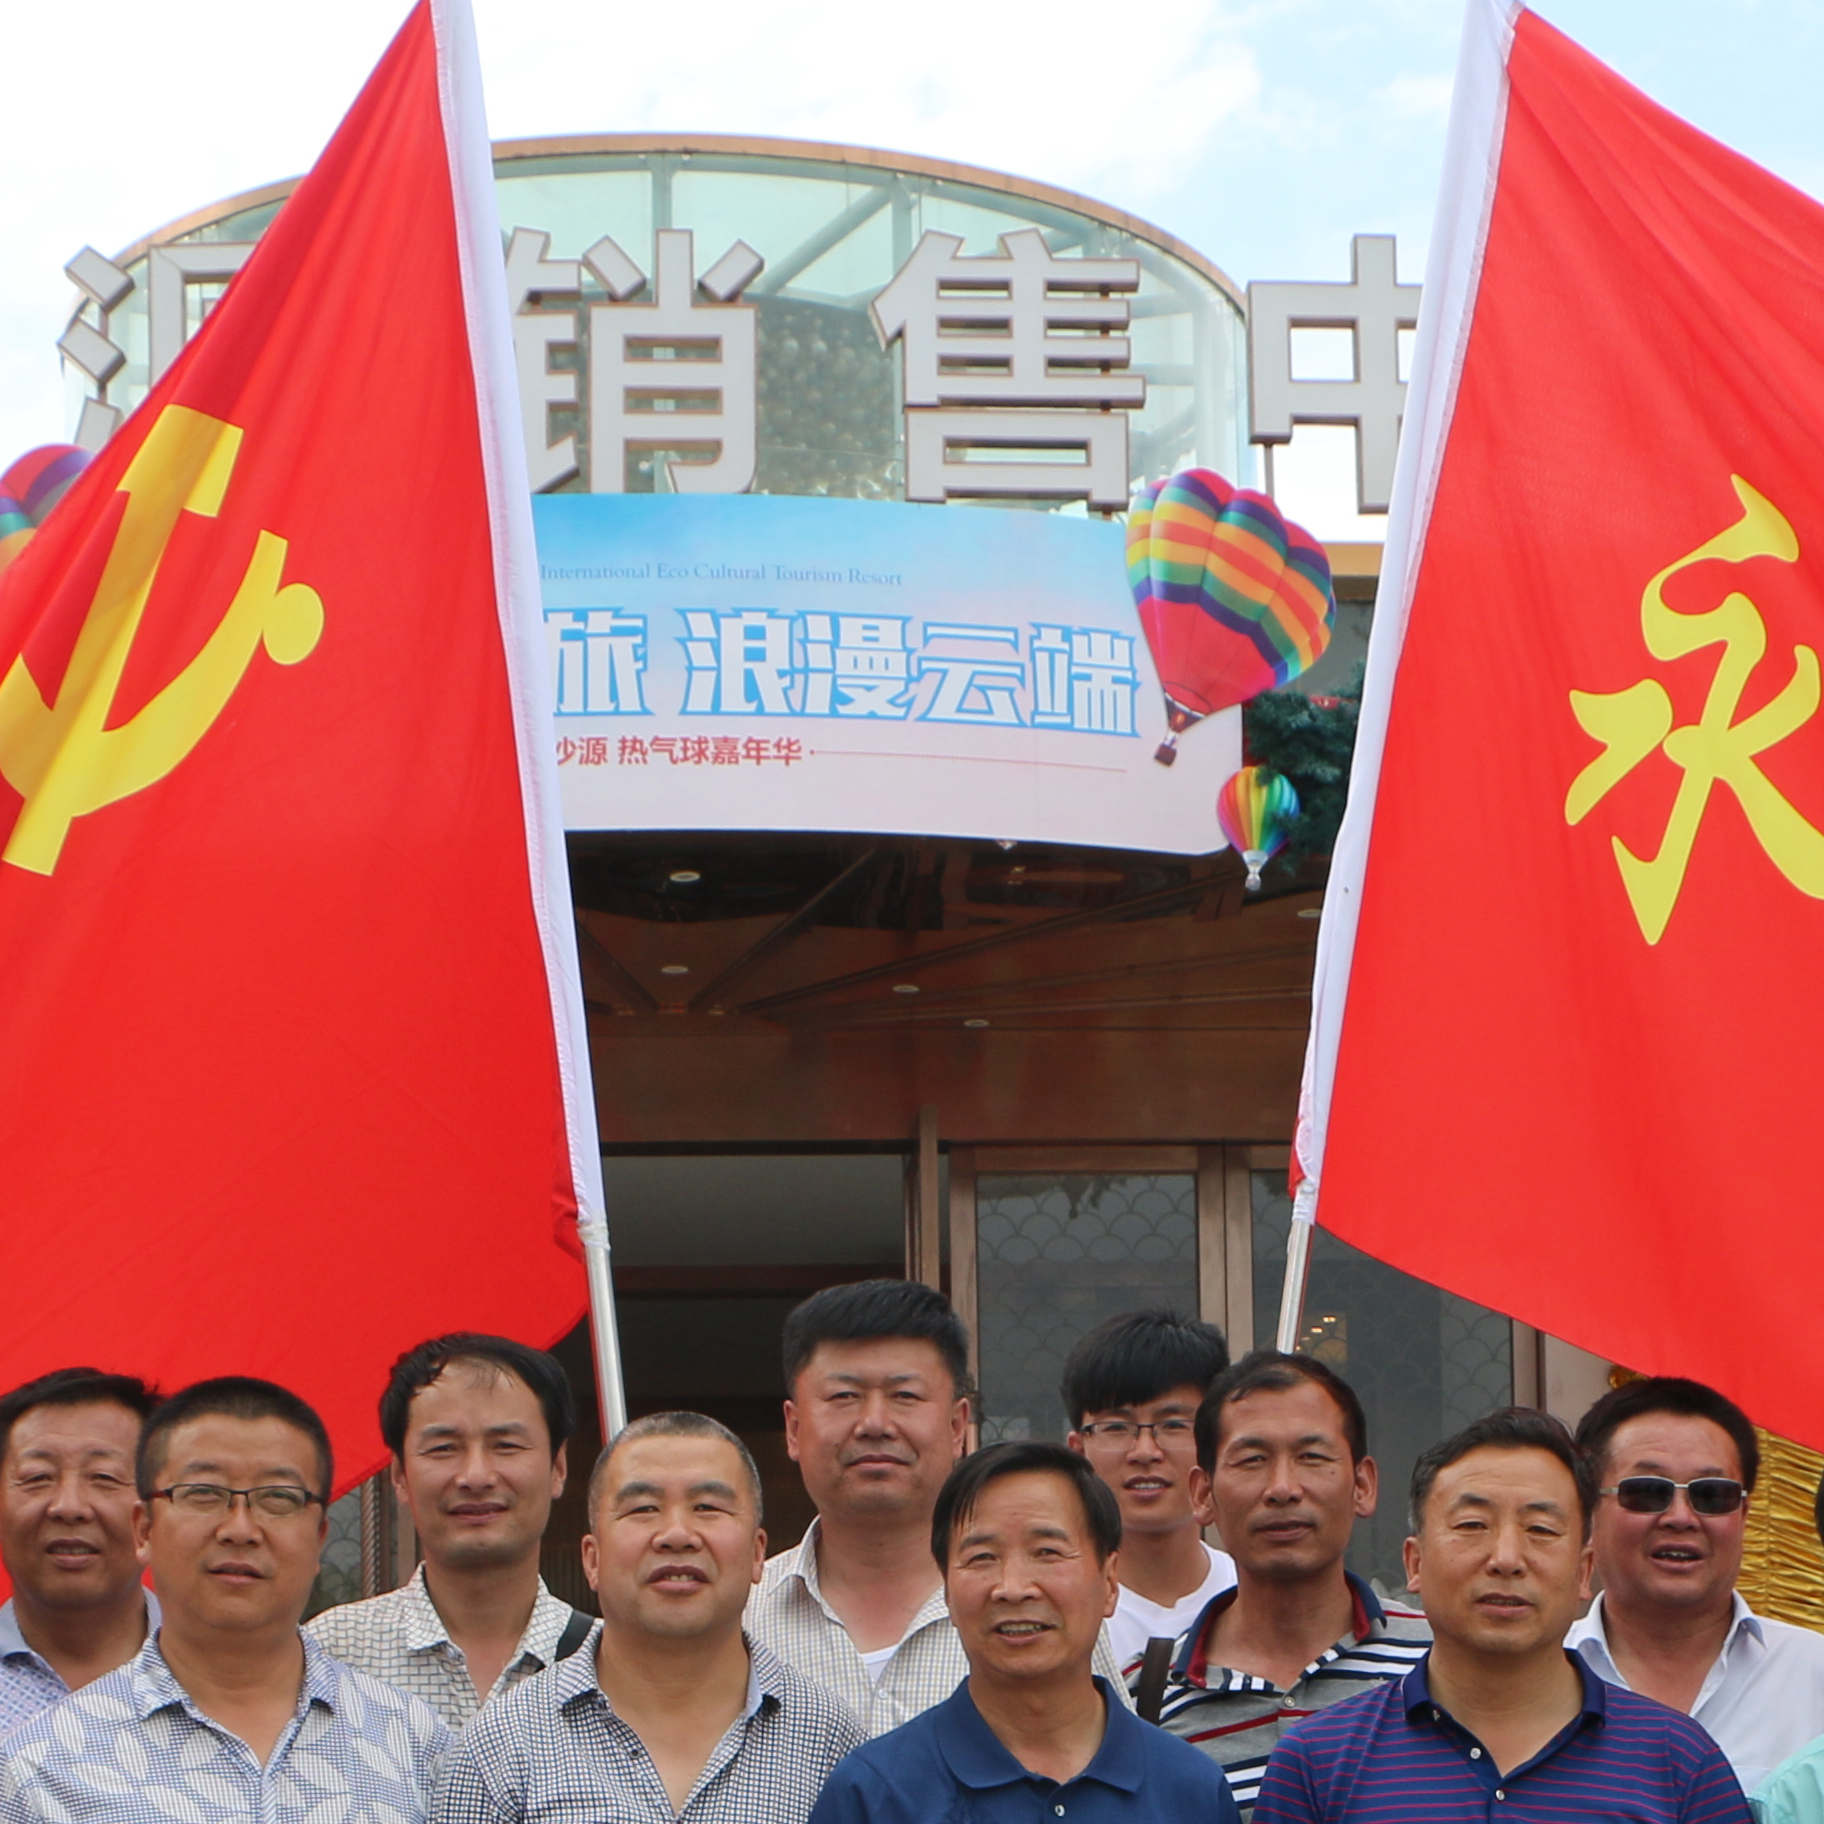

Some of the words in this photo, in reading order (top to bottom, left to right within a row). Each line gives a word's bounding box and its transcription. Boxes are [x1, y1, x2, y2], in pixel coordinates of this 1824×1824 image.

[541, 563, 651, 581] International
[656, 563, 689, 580] Eco
[693, 563, 766, 581] Cultural
[770, 564, 843, 584] Tourism
[847, 567, 904, 587] Resort
[674, 606, 1142, 739] 浪漫云端
[617, 736, 803, 768] 热气球嘉年华
